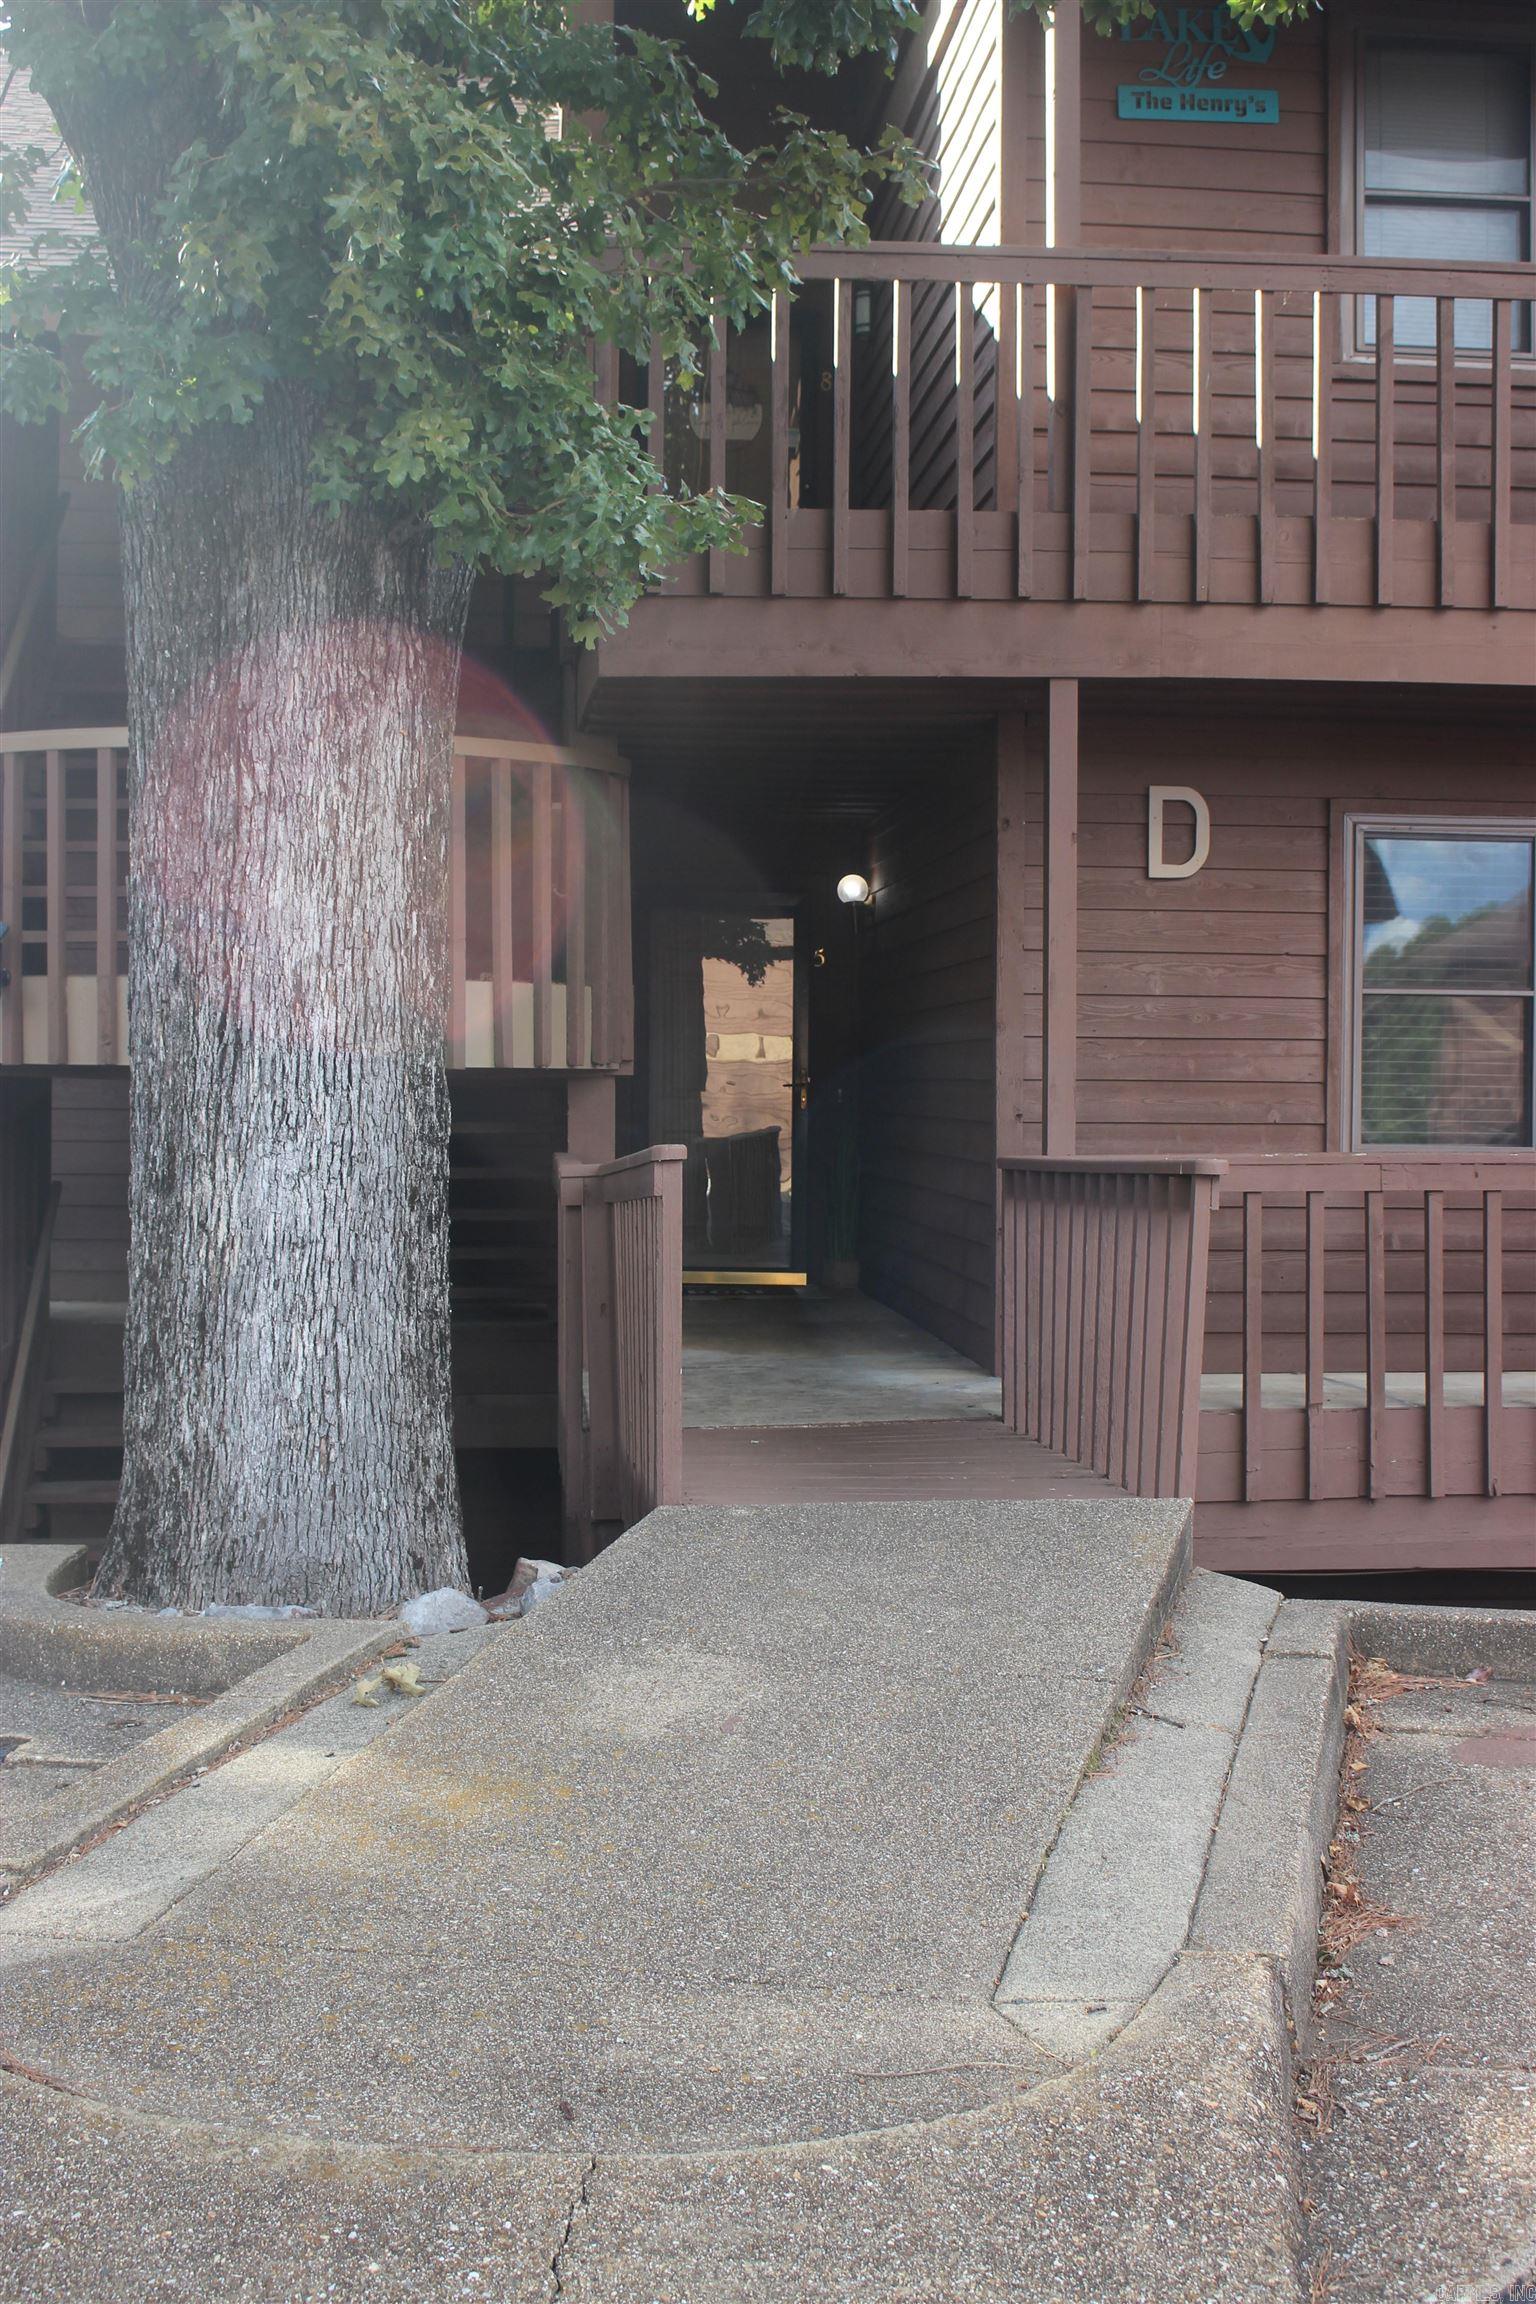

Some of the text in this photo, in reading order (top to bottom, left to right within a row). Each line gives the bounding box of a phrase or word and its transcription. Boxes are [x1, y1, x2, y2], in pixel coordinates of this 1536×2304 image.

[1138, 41, 1227, 89] Life
[1131, 91, 1267, 118] The Henry's
[821, 371, 832, 392] 8
[1148, 785, 1210, 879] D
[813, 946, 825, 968] 5
